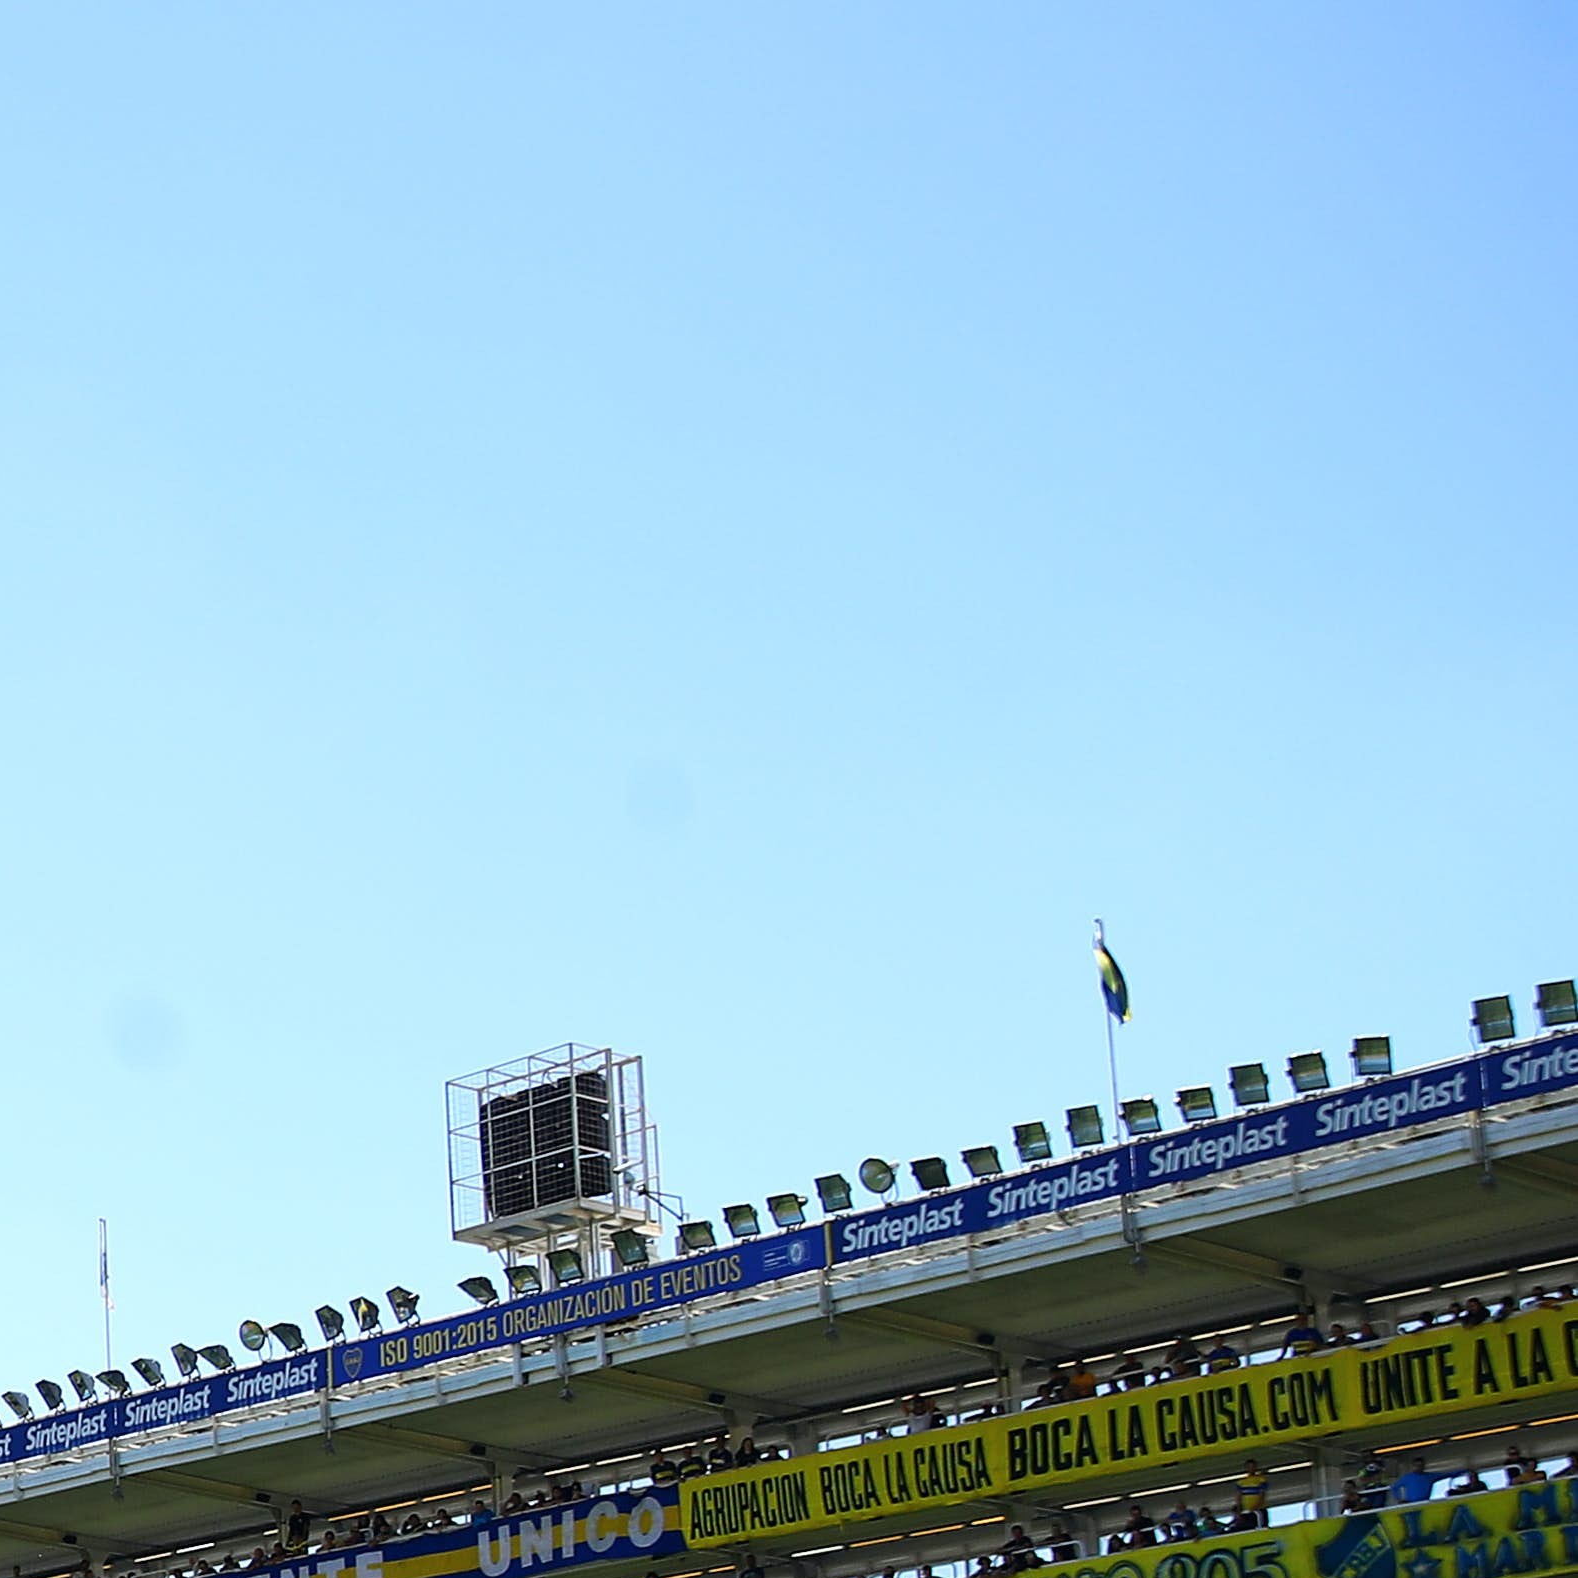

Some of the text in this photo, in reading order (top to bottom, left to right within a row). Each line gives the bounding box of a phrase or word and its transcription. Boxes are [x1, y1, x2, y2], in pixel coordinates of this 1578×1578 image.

[1315, 1070, 1467, 1138] Sinteplast
[1148, 1115, 1290, 1177] Sinteplast
[987, 1156, 1120, 1217] Sinteplast
[841, 1198, 964, 1253] Sinteplast
[378, 1254, 742, 1367] ISO 9001:2015 ORGANIZACIÓN DE EVENTOS
[125, 1383, 211, 1428] Sinteplast
[227, 1356, 318, 1403] Sinteplast
[26, 1408, 107, 1450] Sinteplast
[690, 1321, 1553, 1540] AGRUPACION BOCA LA CAUSA BOCA LA CAUSA.COM UNITE A LA
[476, 1496, 665, 1578] UNICO
